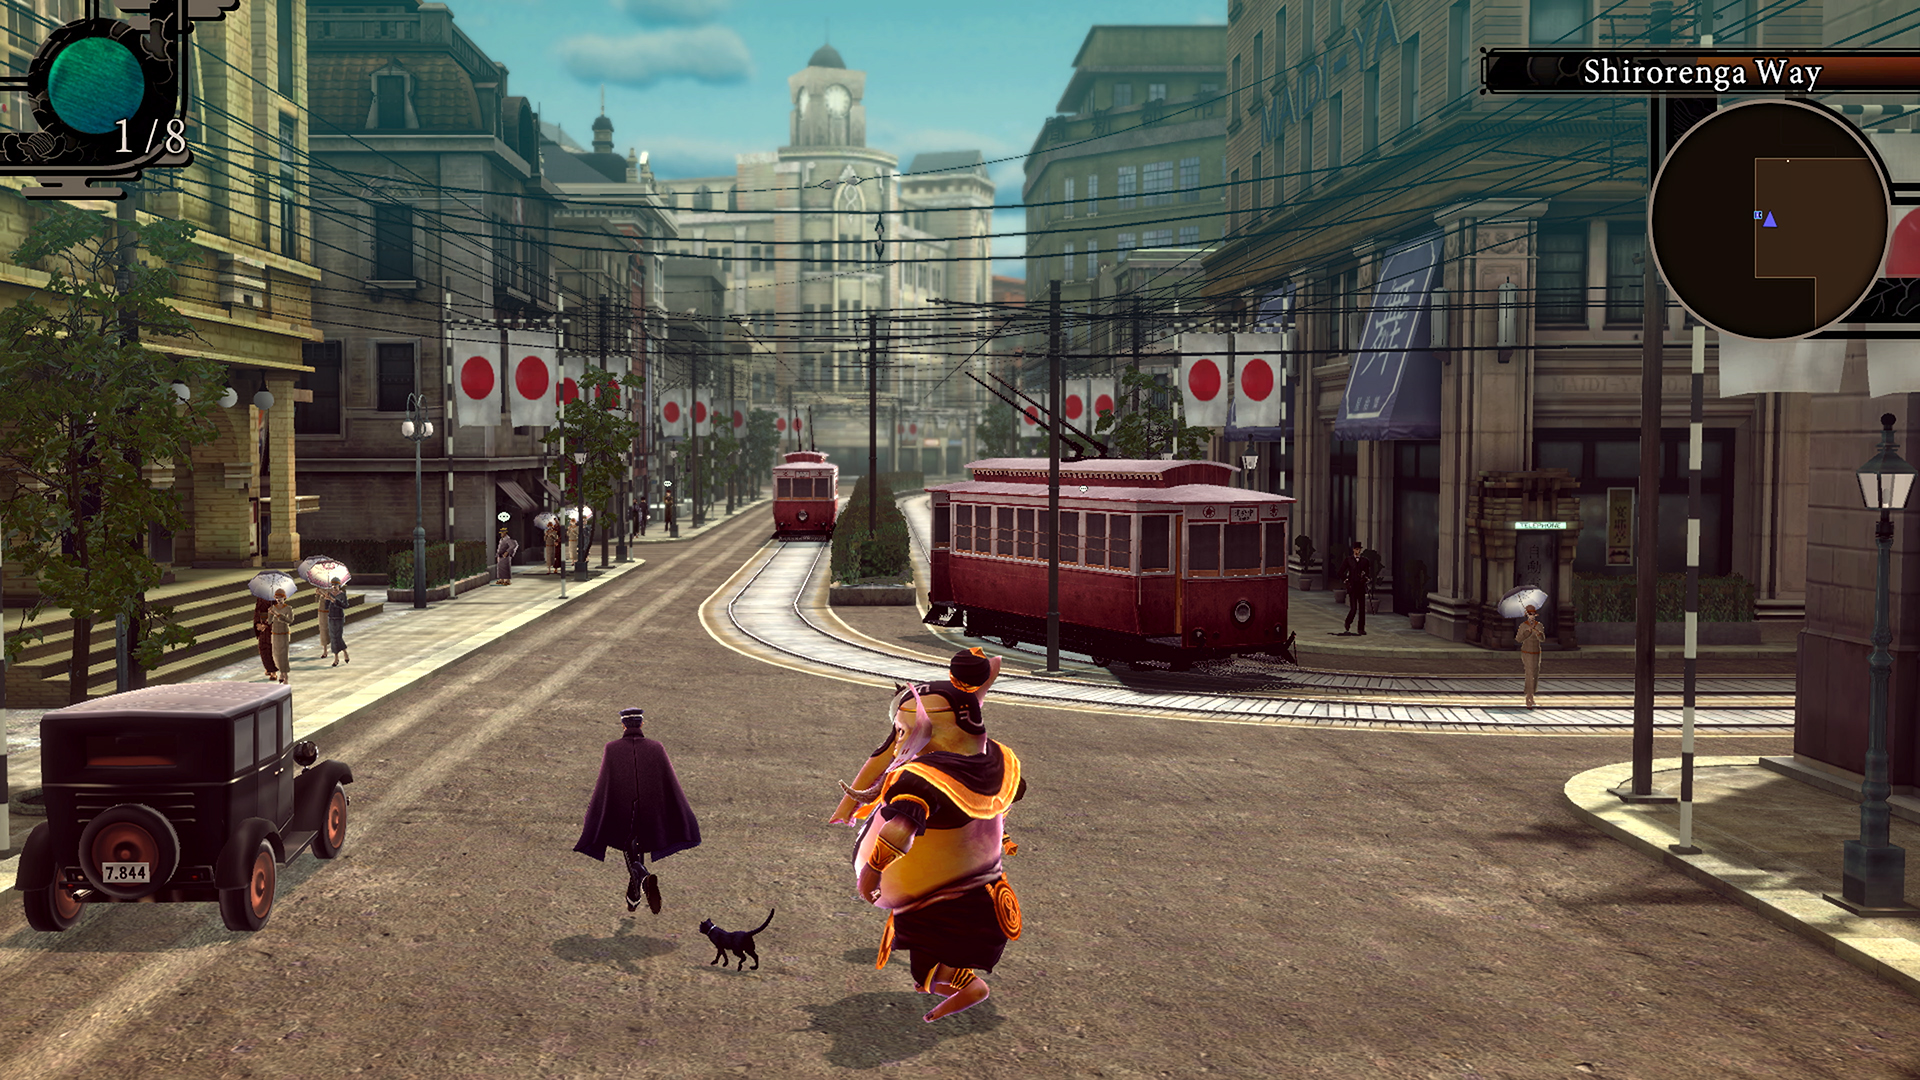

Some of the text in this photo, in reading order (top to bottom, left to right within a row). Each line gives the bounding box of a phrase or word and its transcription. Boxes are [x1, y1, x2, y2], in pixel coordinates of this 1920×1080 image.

[1260, 0, 1400, 148] MAIDI-YA
[1519, 521, 1562, 530] TELEPHONE
[105, 865, 146, 880] 7.844
